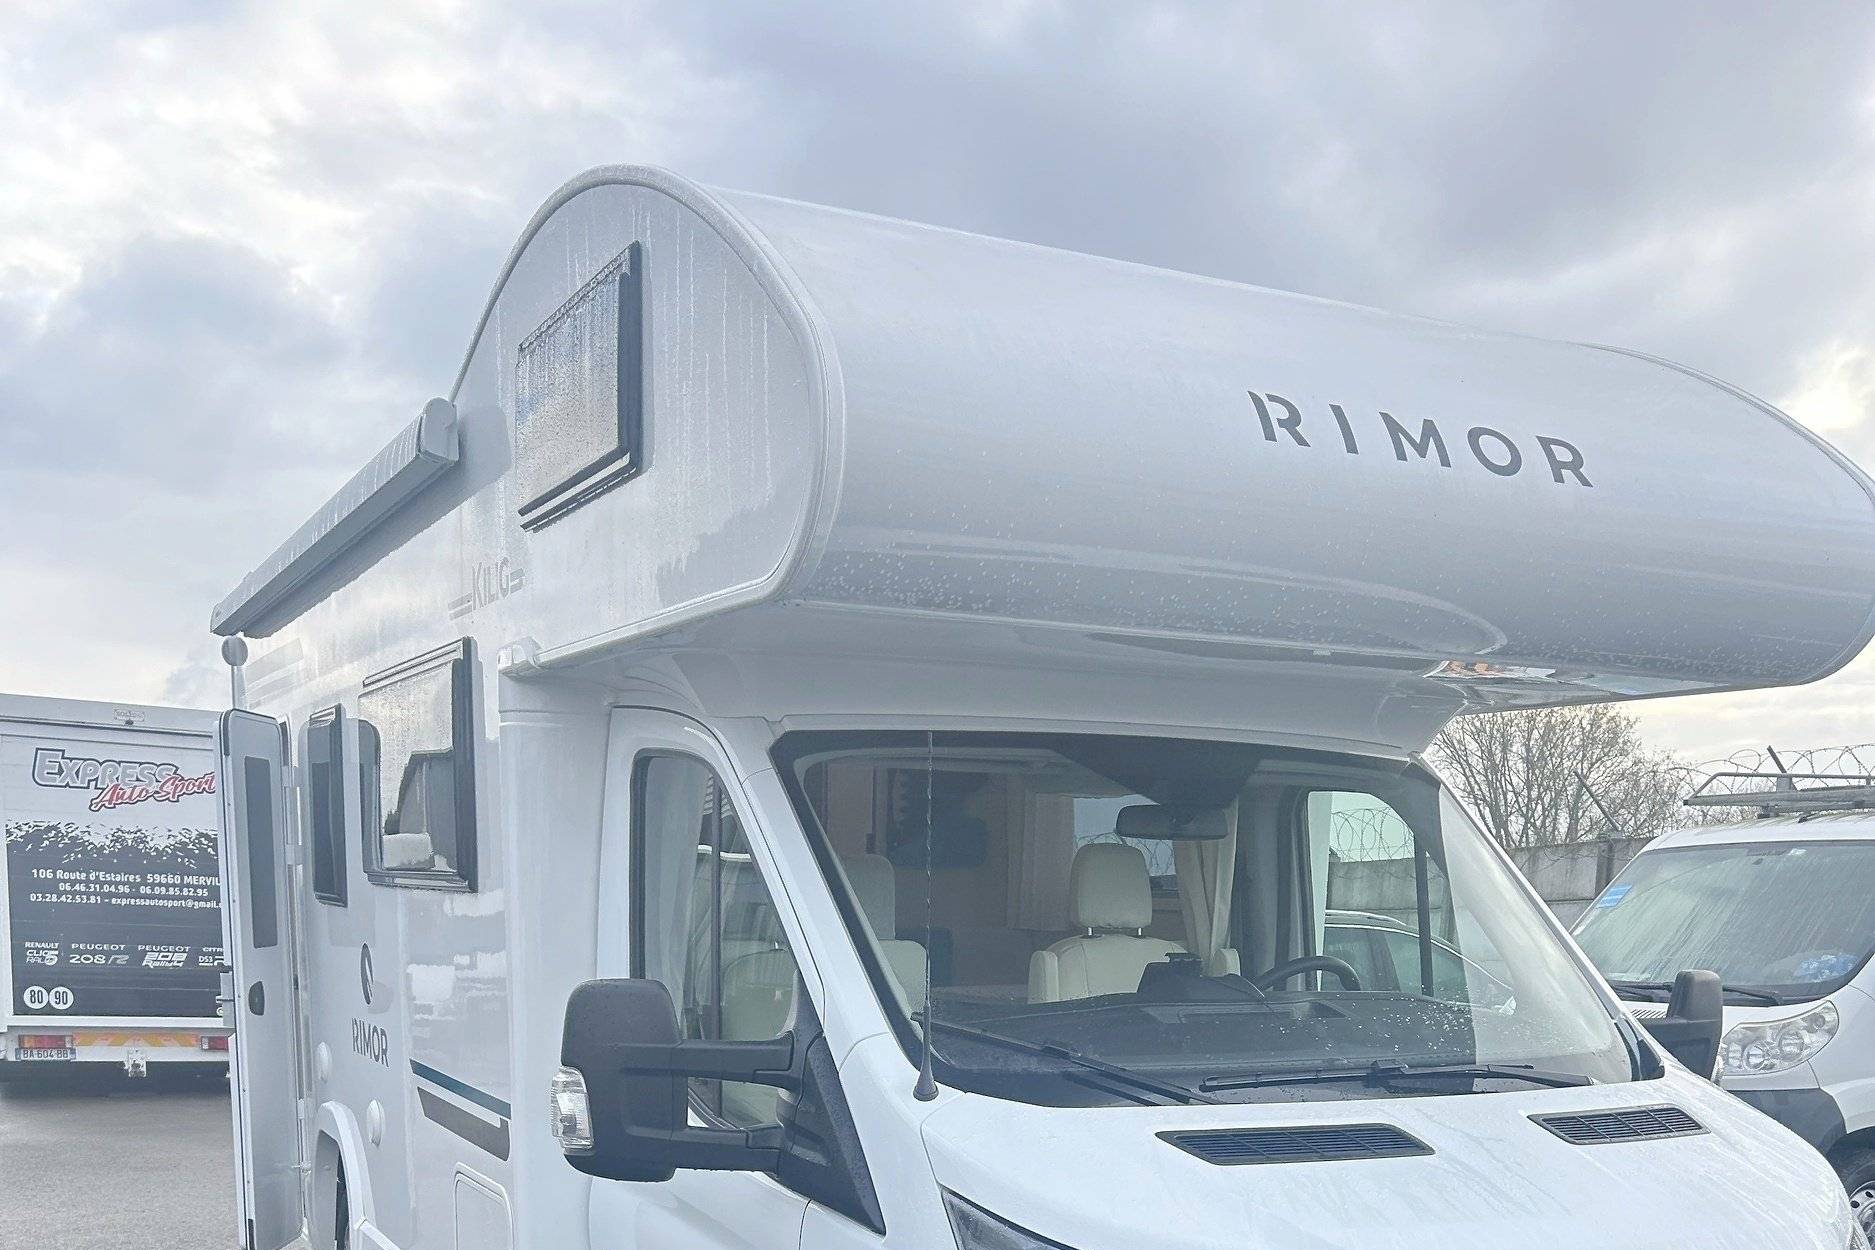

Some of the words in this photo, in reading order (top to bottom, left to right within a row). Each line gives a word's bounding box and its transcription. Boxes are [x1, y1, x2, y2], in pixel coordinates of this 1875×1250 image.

[1247, 390, 1593, 488] RIMOR
[33, 748, 181, 789] EXPRESS
[90, 783, 153, 812] Auto
[152, 771, 216, 802] Sport
[31, 869, 54, 878] 106
[56, 870, 87, 880] Route
[89, 870, 142, 883] d'Estaires
[146, 873, 181, 884] 59660
[58, 882, 131, 894] 06.46.31.04.96
[139, 885, 209, 897] 06.09.85.82.95
[30, 893, 101, 904] 03.28.42.53.81
[25, 941, 60, 949] RENAULT
[71, 943, 126, 951] PEUGEOT
[138, 944, 191, 952] PEUGEOT
[69, 954, 106, 964] 208
[30, 989, 44, 1004] 80
[54, 990, 68, 1005] 90
[352, 1017, 389, 1068] RIMOR
